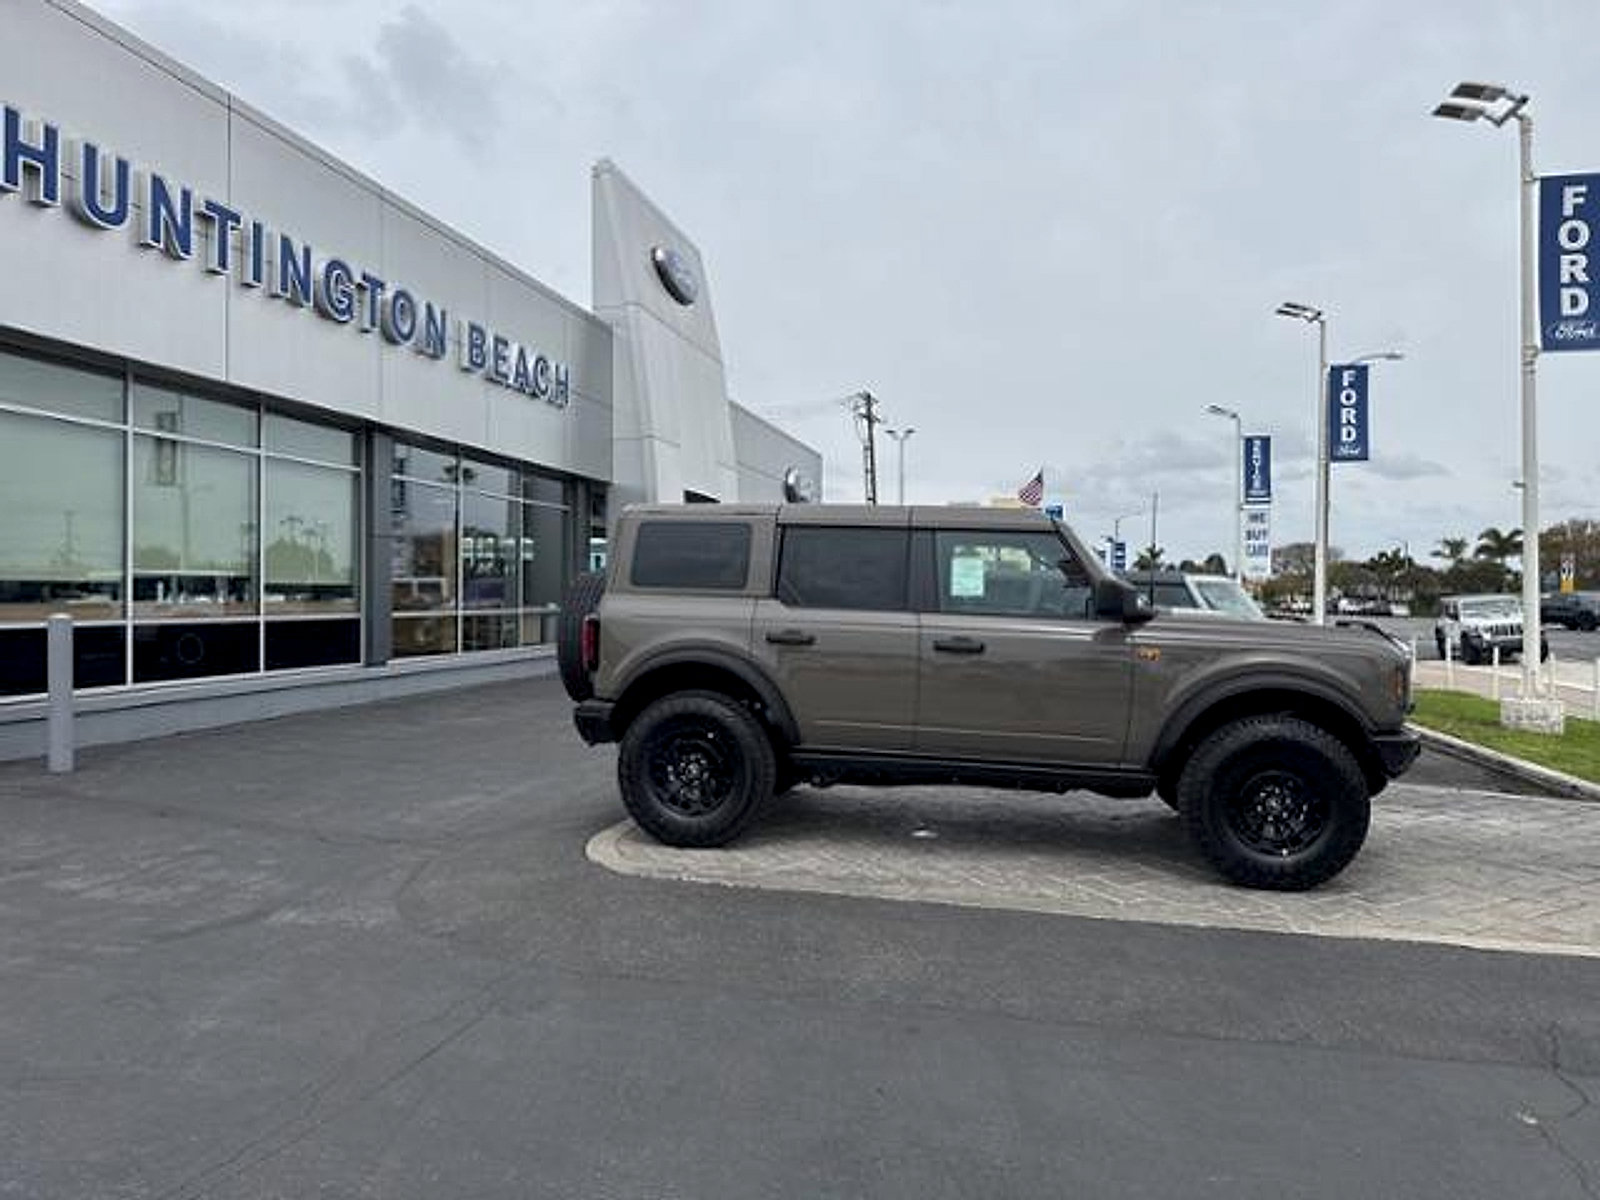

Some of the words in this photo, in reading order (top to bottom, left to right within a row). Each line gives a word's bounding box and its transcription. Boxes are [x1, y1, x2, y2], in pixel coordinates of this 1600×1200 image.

[1, 103, 447, 359] HUNTINGTON
[461, 320, 570, 407] BEACH
[1557, 185, 1590, 317] FORD
[1340, 370, 1357, 442] FORD
[1245, 529, 1268, 541] BUY
